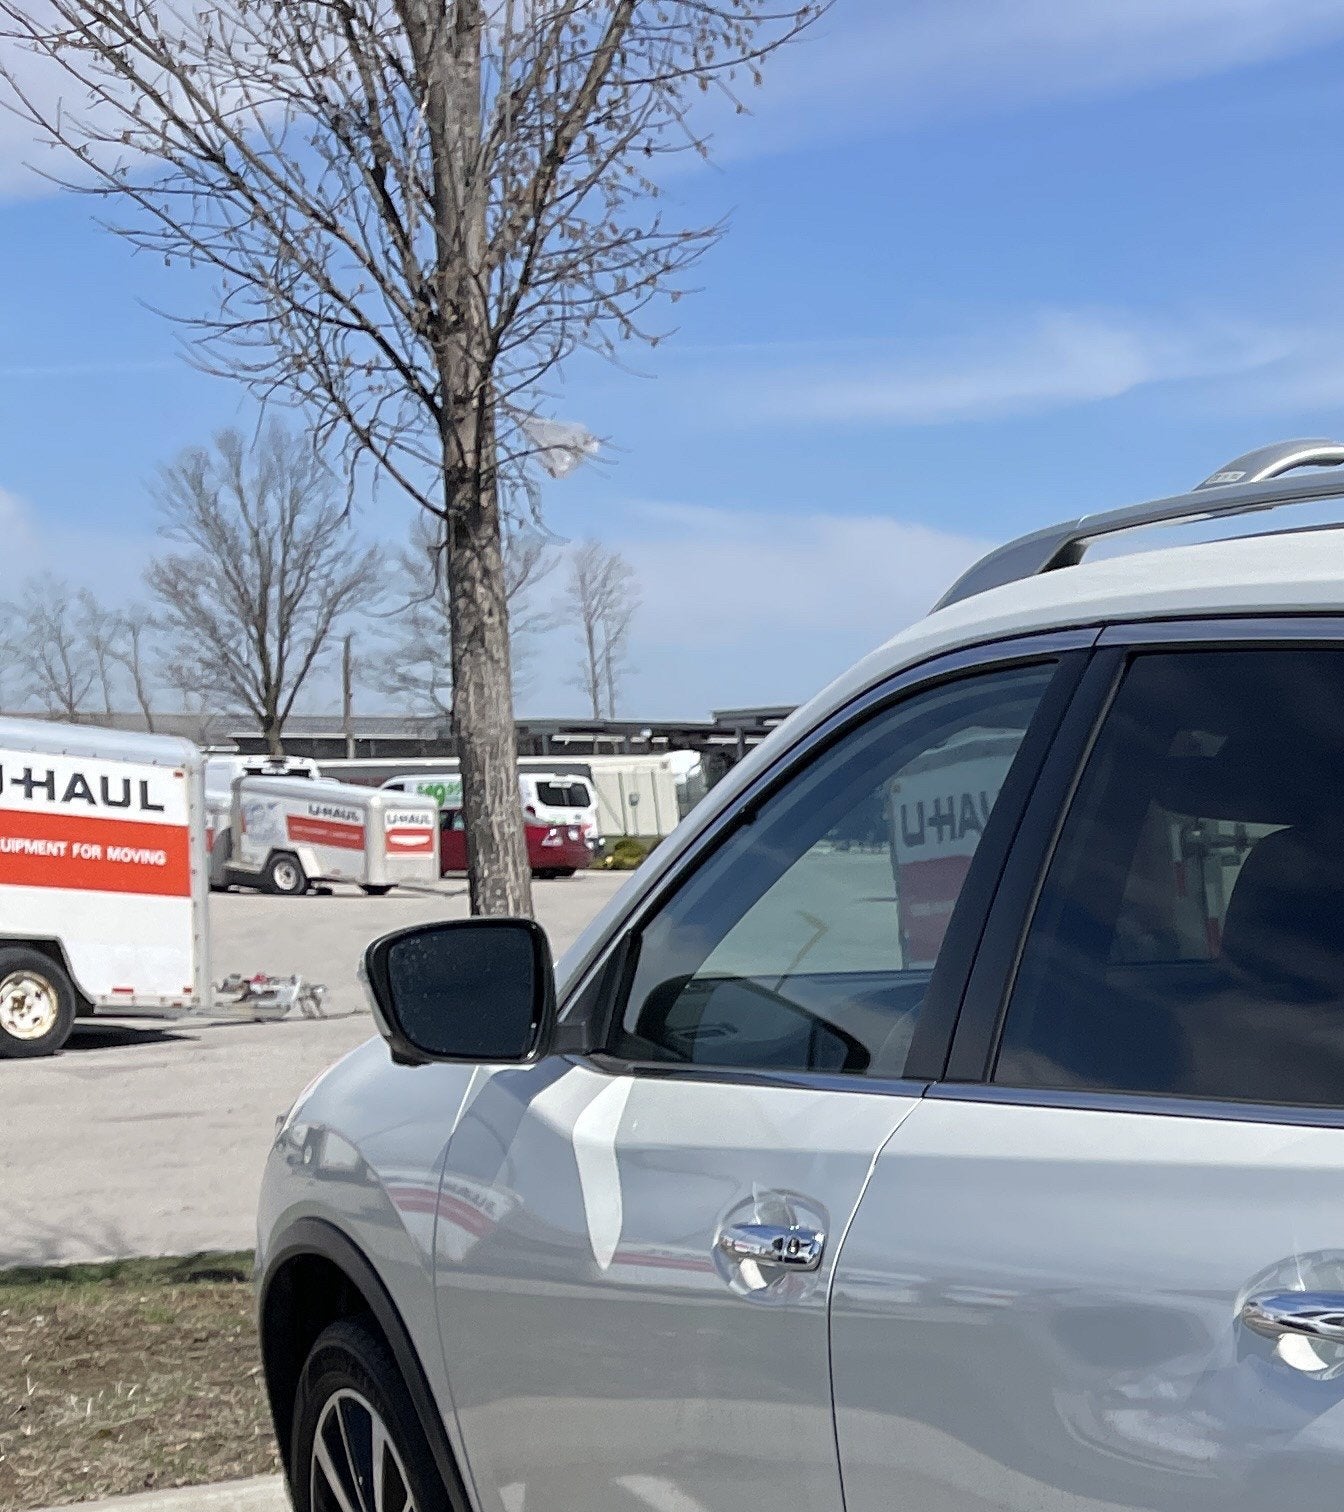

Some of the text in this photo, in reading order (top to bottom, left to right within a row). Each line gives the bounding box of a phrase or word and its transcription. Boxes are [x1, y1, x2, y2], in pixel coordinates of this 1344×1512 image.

[0, 764, 165, 812] -HAUL
[0, 836, 168, 867] UIPMENT FOR MOVING
